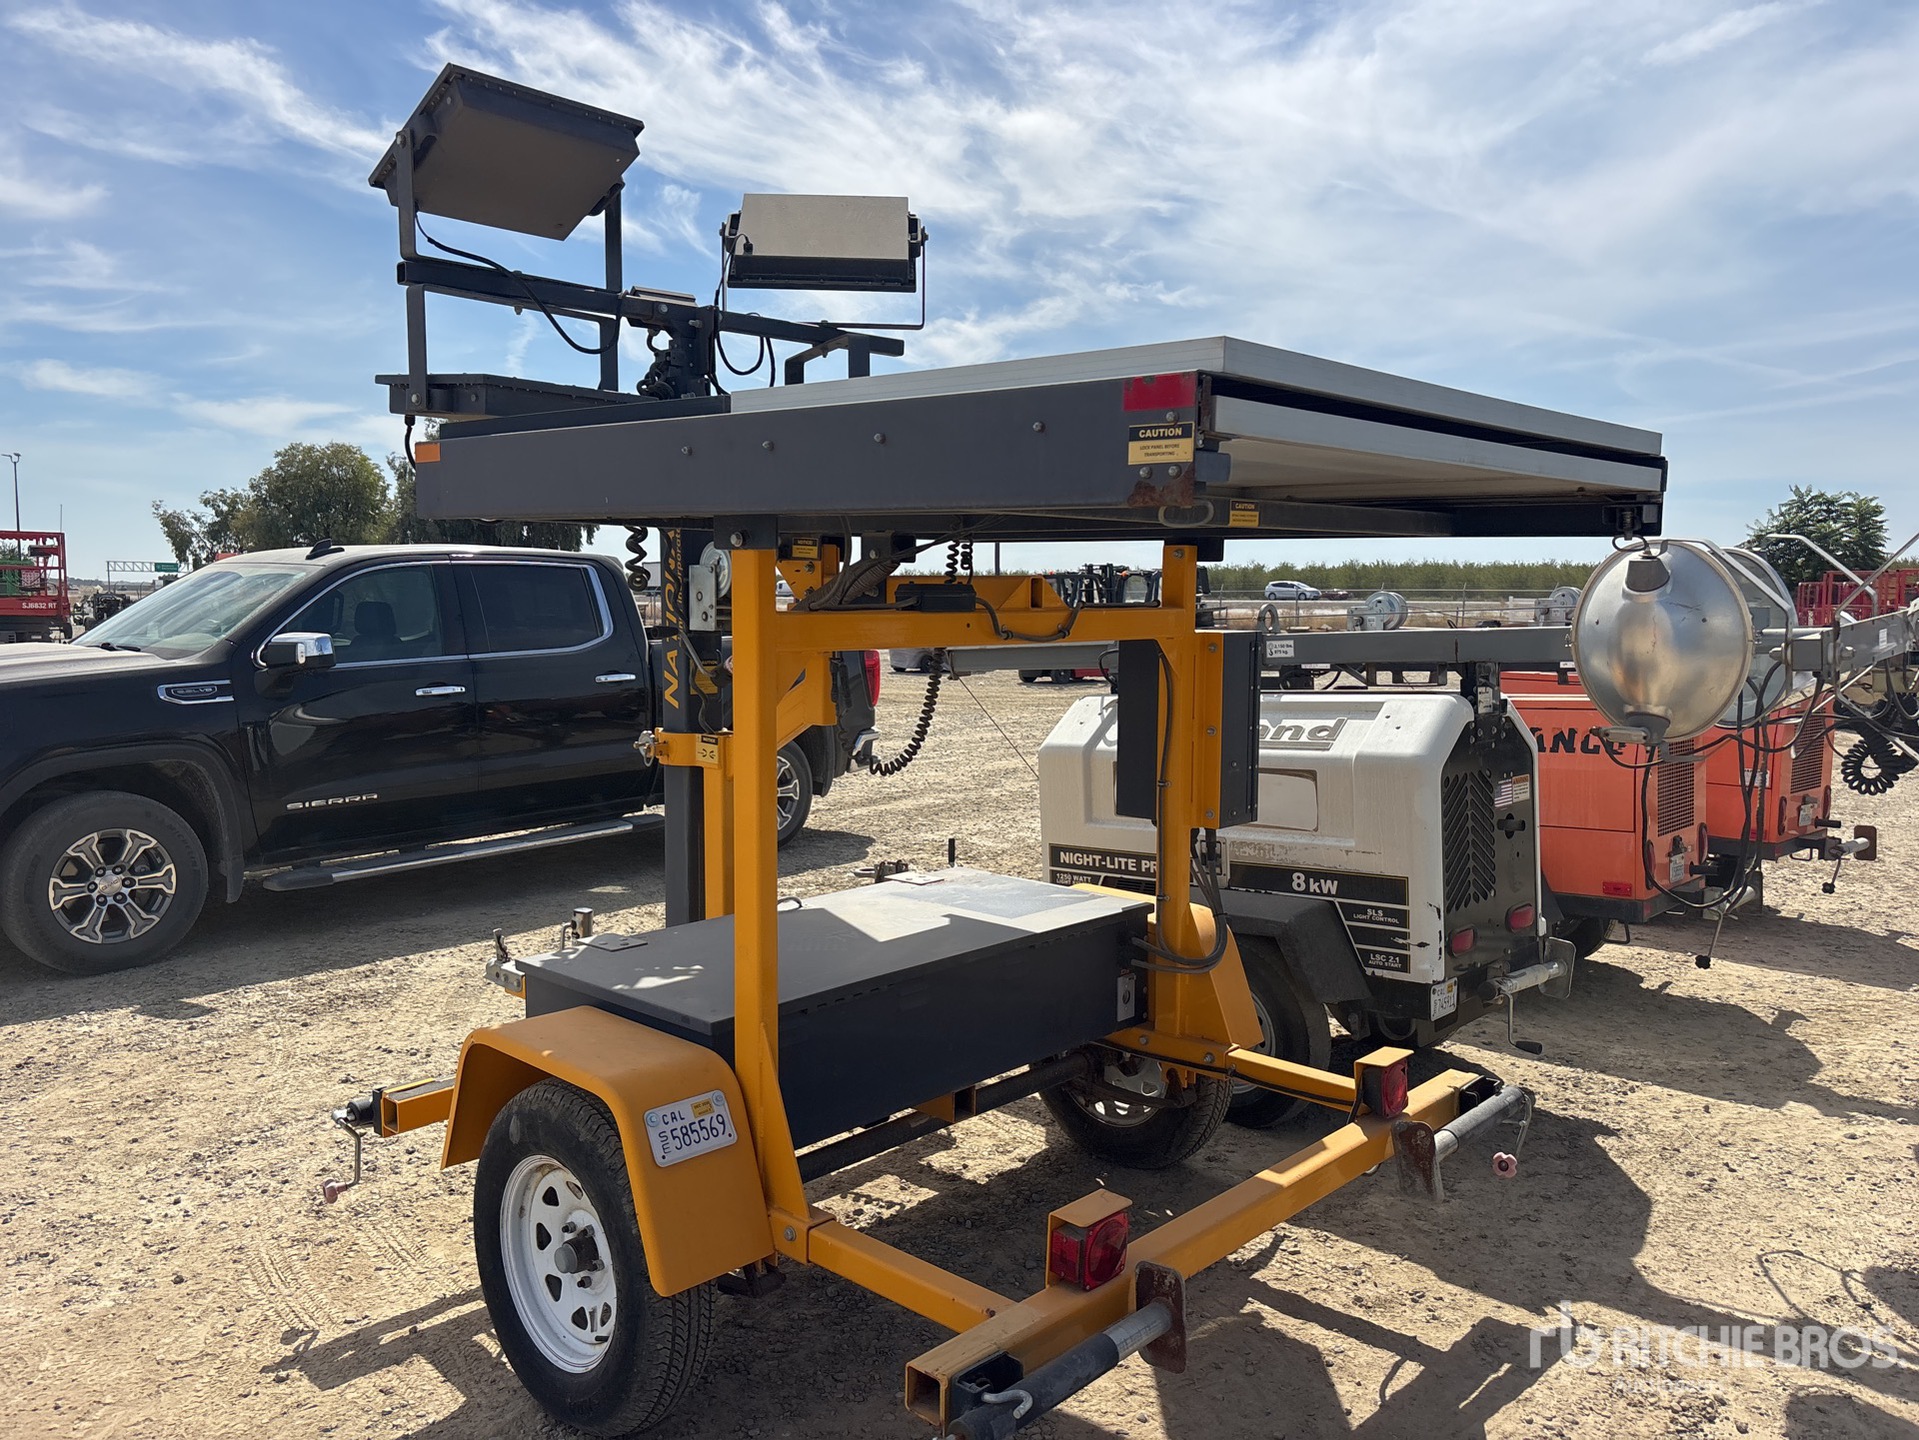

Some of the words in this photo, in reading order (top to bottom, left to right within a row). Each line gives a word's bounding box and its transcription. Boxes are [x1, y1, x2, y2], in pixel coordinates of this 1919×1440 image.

[1139, 428, 1182, 438] CAUTION
[286, 793, 378, 811] SIERRA
[1060, 851, 1137, 871] NIGHT-LITE
[1073, 874, 1092, 883] WATT
[1291, 872, 1305, 892] 8
[1309, 878, 1338, 895] kW
[101, 879, 119, 891] GMC
[1367, 908, 1384, 917] SLS
[1371, 915, 1400, 924] CONTROL
[1370, 953, 1387, 962] LSC
[1388, 955, 1400, 964] 2.1
[661, 1110, 685, 1125] CAL
[658, 1131, 672, 1154] SE
[670, 1113, 726, 1150] 585569
